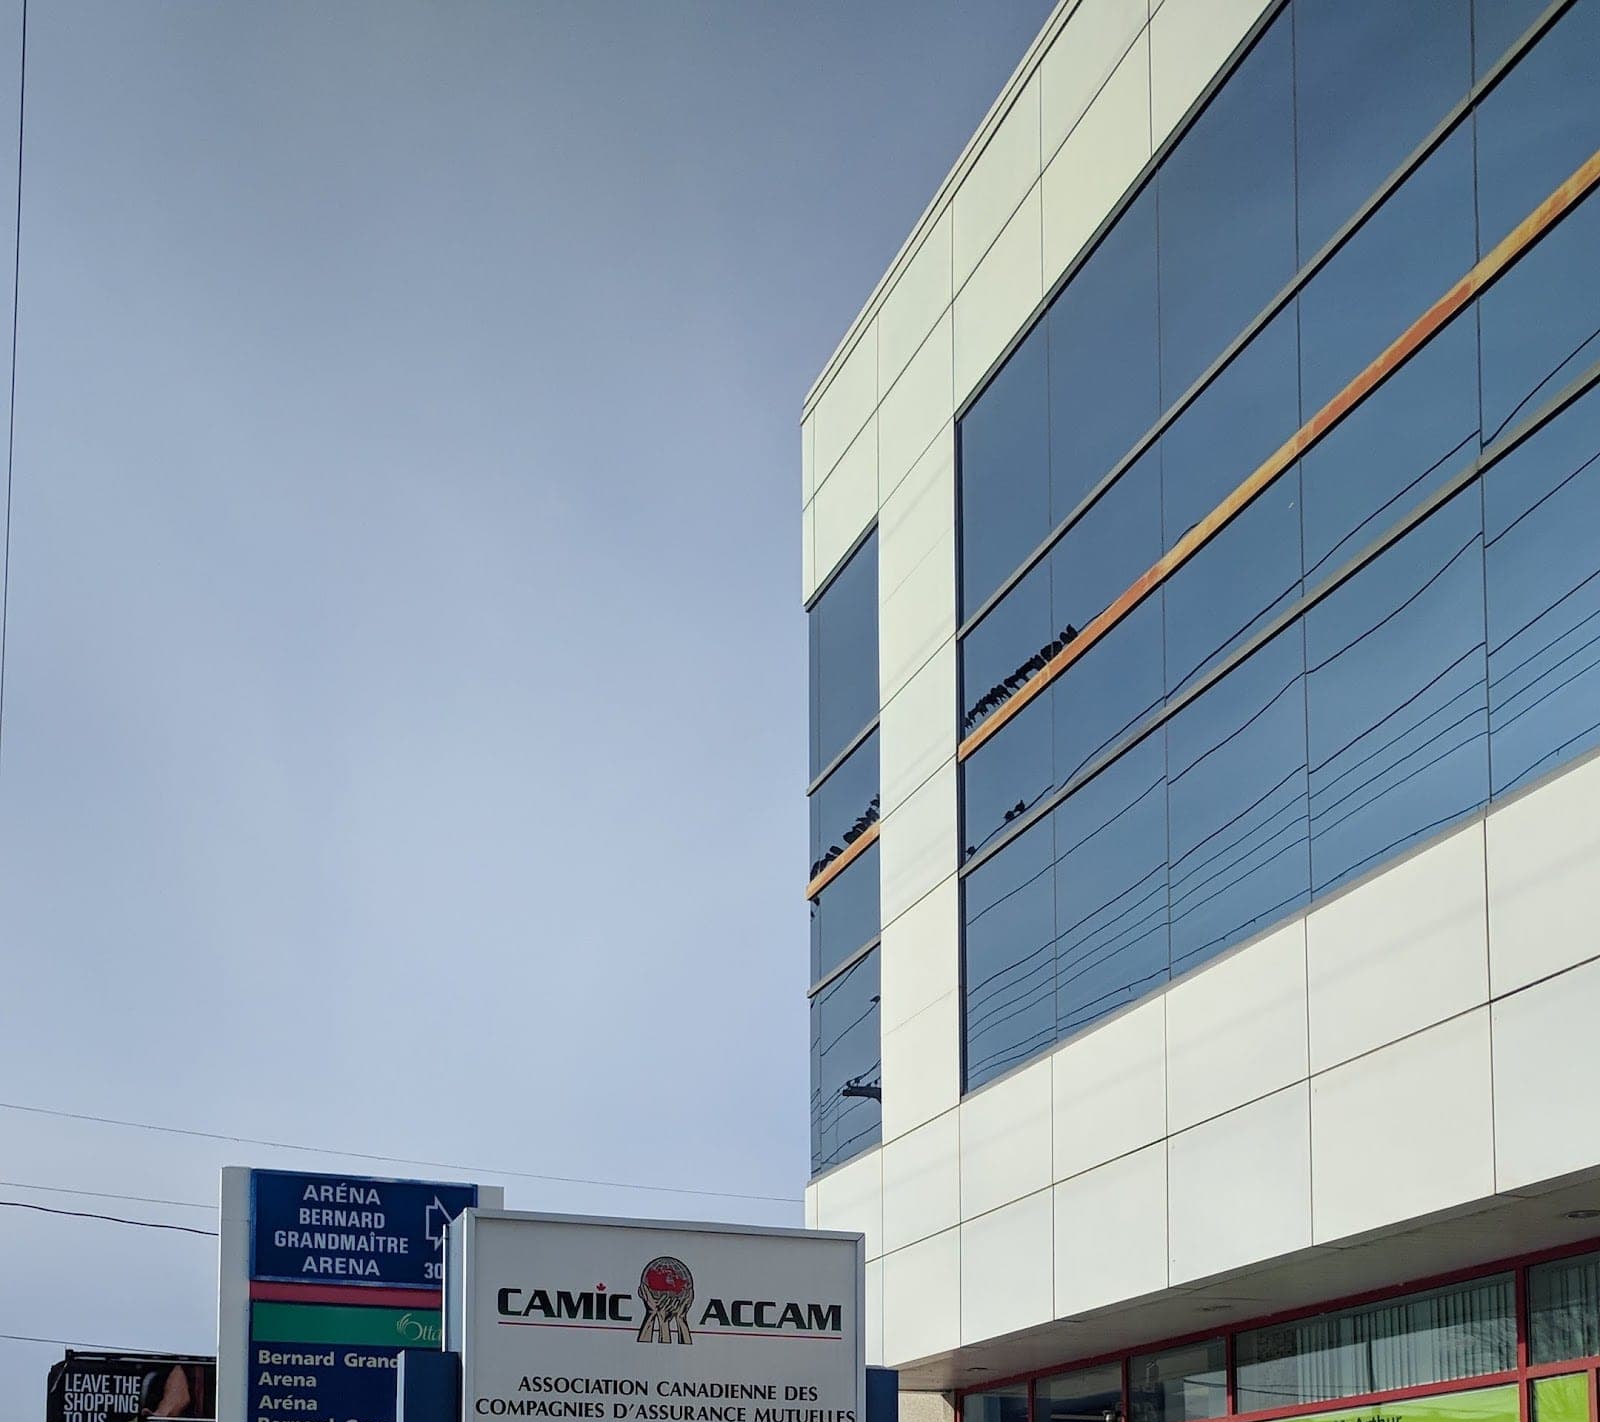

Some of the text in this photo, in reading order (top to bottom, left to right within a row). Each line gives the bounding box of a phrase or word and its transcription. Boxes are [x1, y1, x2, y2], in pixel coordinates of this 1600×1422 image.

[303, 1183, 381, 1205] ARÉNA
[299, 1208, 385, 1229] BERNARD
[274, 1230, 409, 1254] GRANDMAÎTRE
[302, 1256, 380, 1276] ARENA
[699, 1298, 842, 1332] ACCAM
[258, 1350, 335, 1367] Bernard
[65, 1373, 142, 1395] LEAVE THE
[258, 1372, 317, 1387] Arena
[518, 1376, 818, 1402] ASSOCIATION CANADIENNE DES
[64, 1393, 139, 1414] SHOPPING
[258, 1395, 317, 1411] Aréna
[475, 1398, 605, 1419] COMPAGNIES
[613, 1402, 746, 1422] D'ASSURANCE
